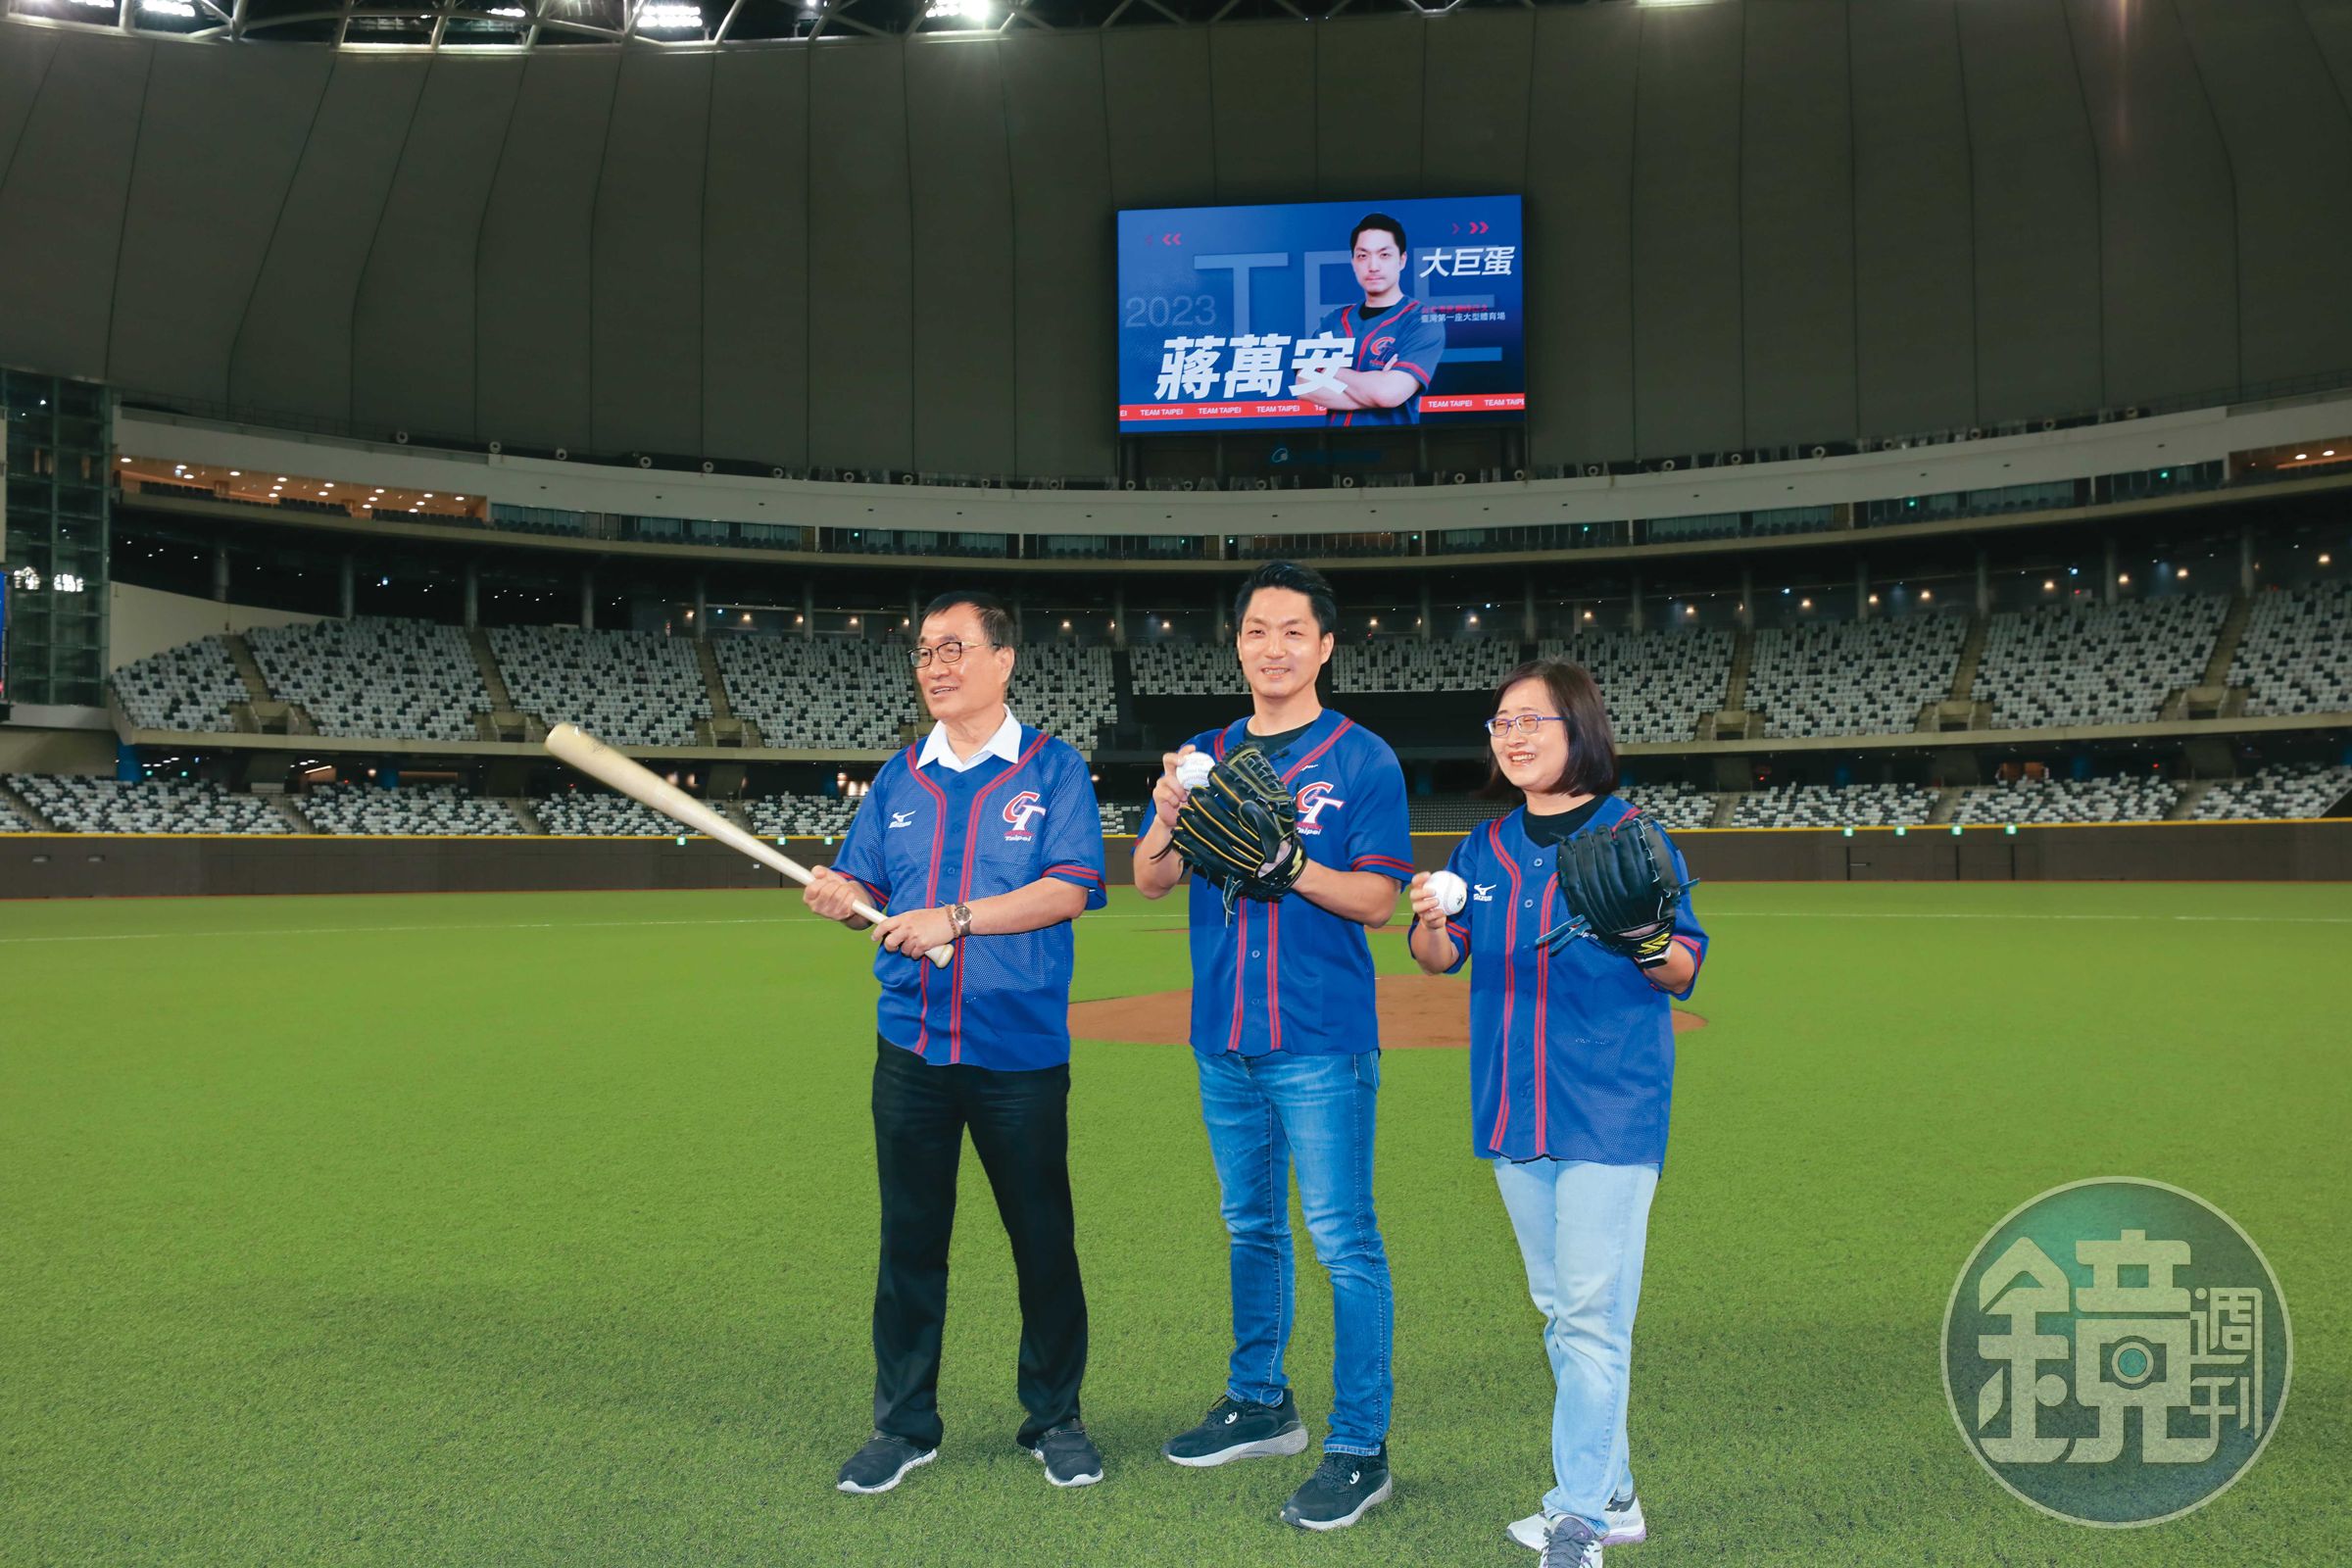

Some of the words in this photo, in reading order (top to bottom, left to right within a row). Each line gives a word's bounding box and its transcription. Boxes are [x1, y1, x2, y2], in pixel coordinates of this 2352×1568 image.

[1420, 246, 1515, 278] 大巨蛋
[1126, 295, 1216, 327] 2023
[1154, 330, 1355, 400] 蔣萬安
